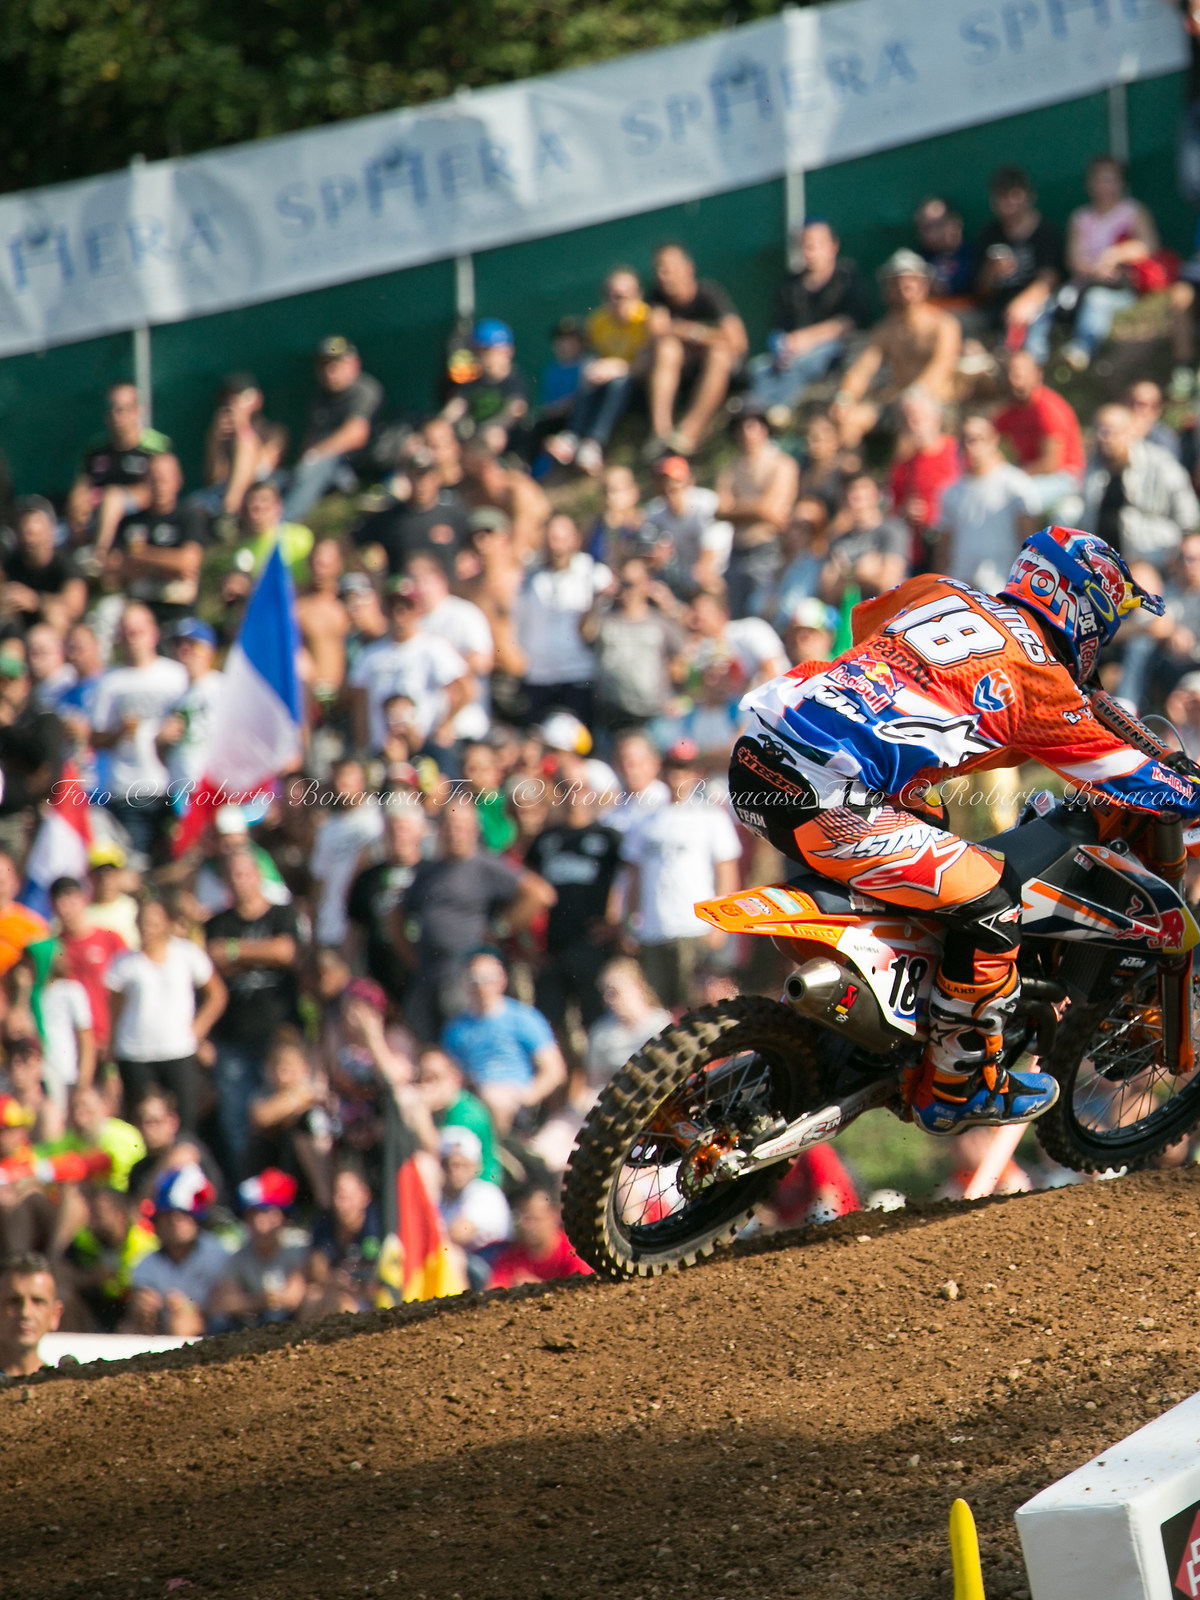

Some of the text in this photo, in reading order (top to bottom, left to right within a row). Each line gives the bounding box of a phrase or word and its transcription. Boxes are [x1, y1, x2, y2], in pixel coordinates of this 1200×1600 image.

[621, 40, 918, 156] SPHERA
[275, 129, 571, 238] SPHERA
[884, 594, 1007, 666] 18
[1095, 698, 1163, 758] RENTHAL
[888, 955, 928, 1012] 18
